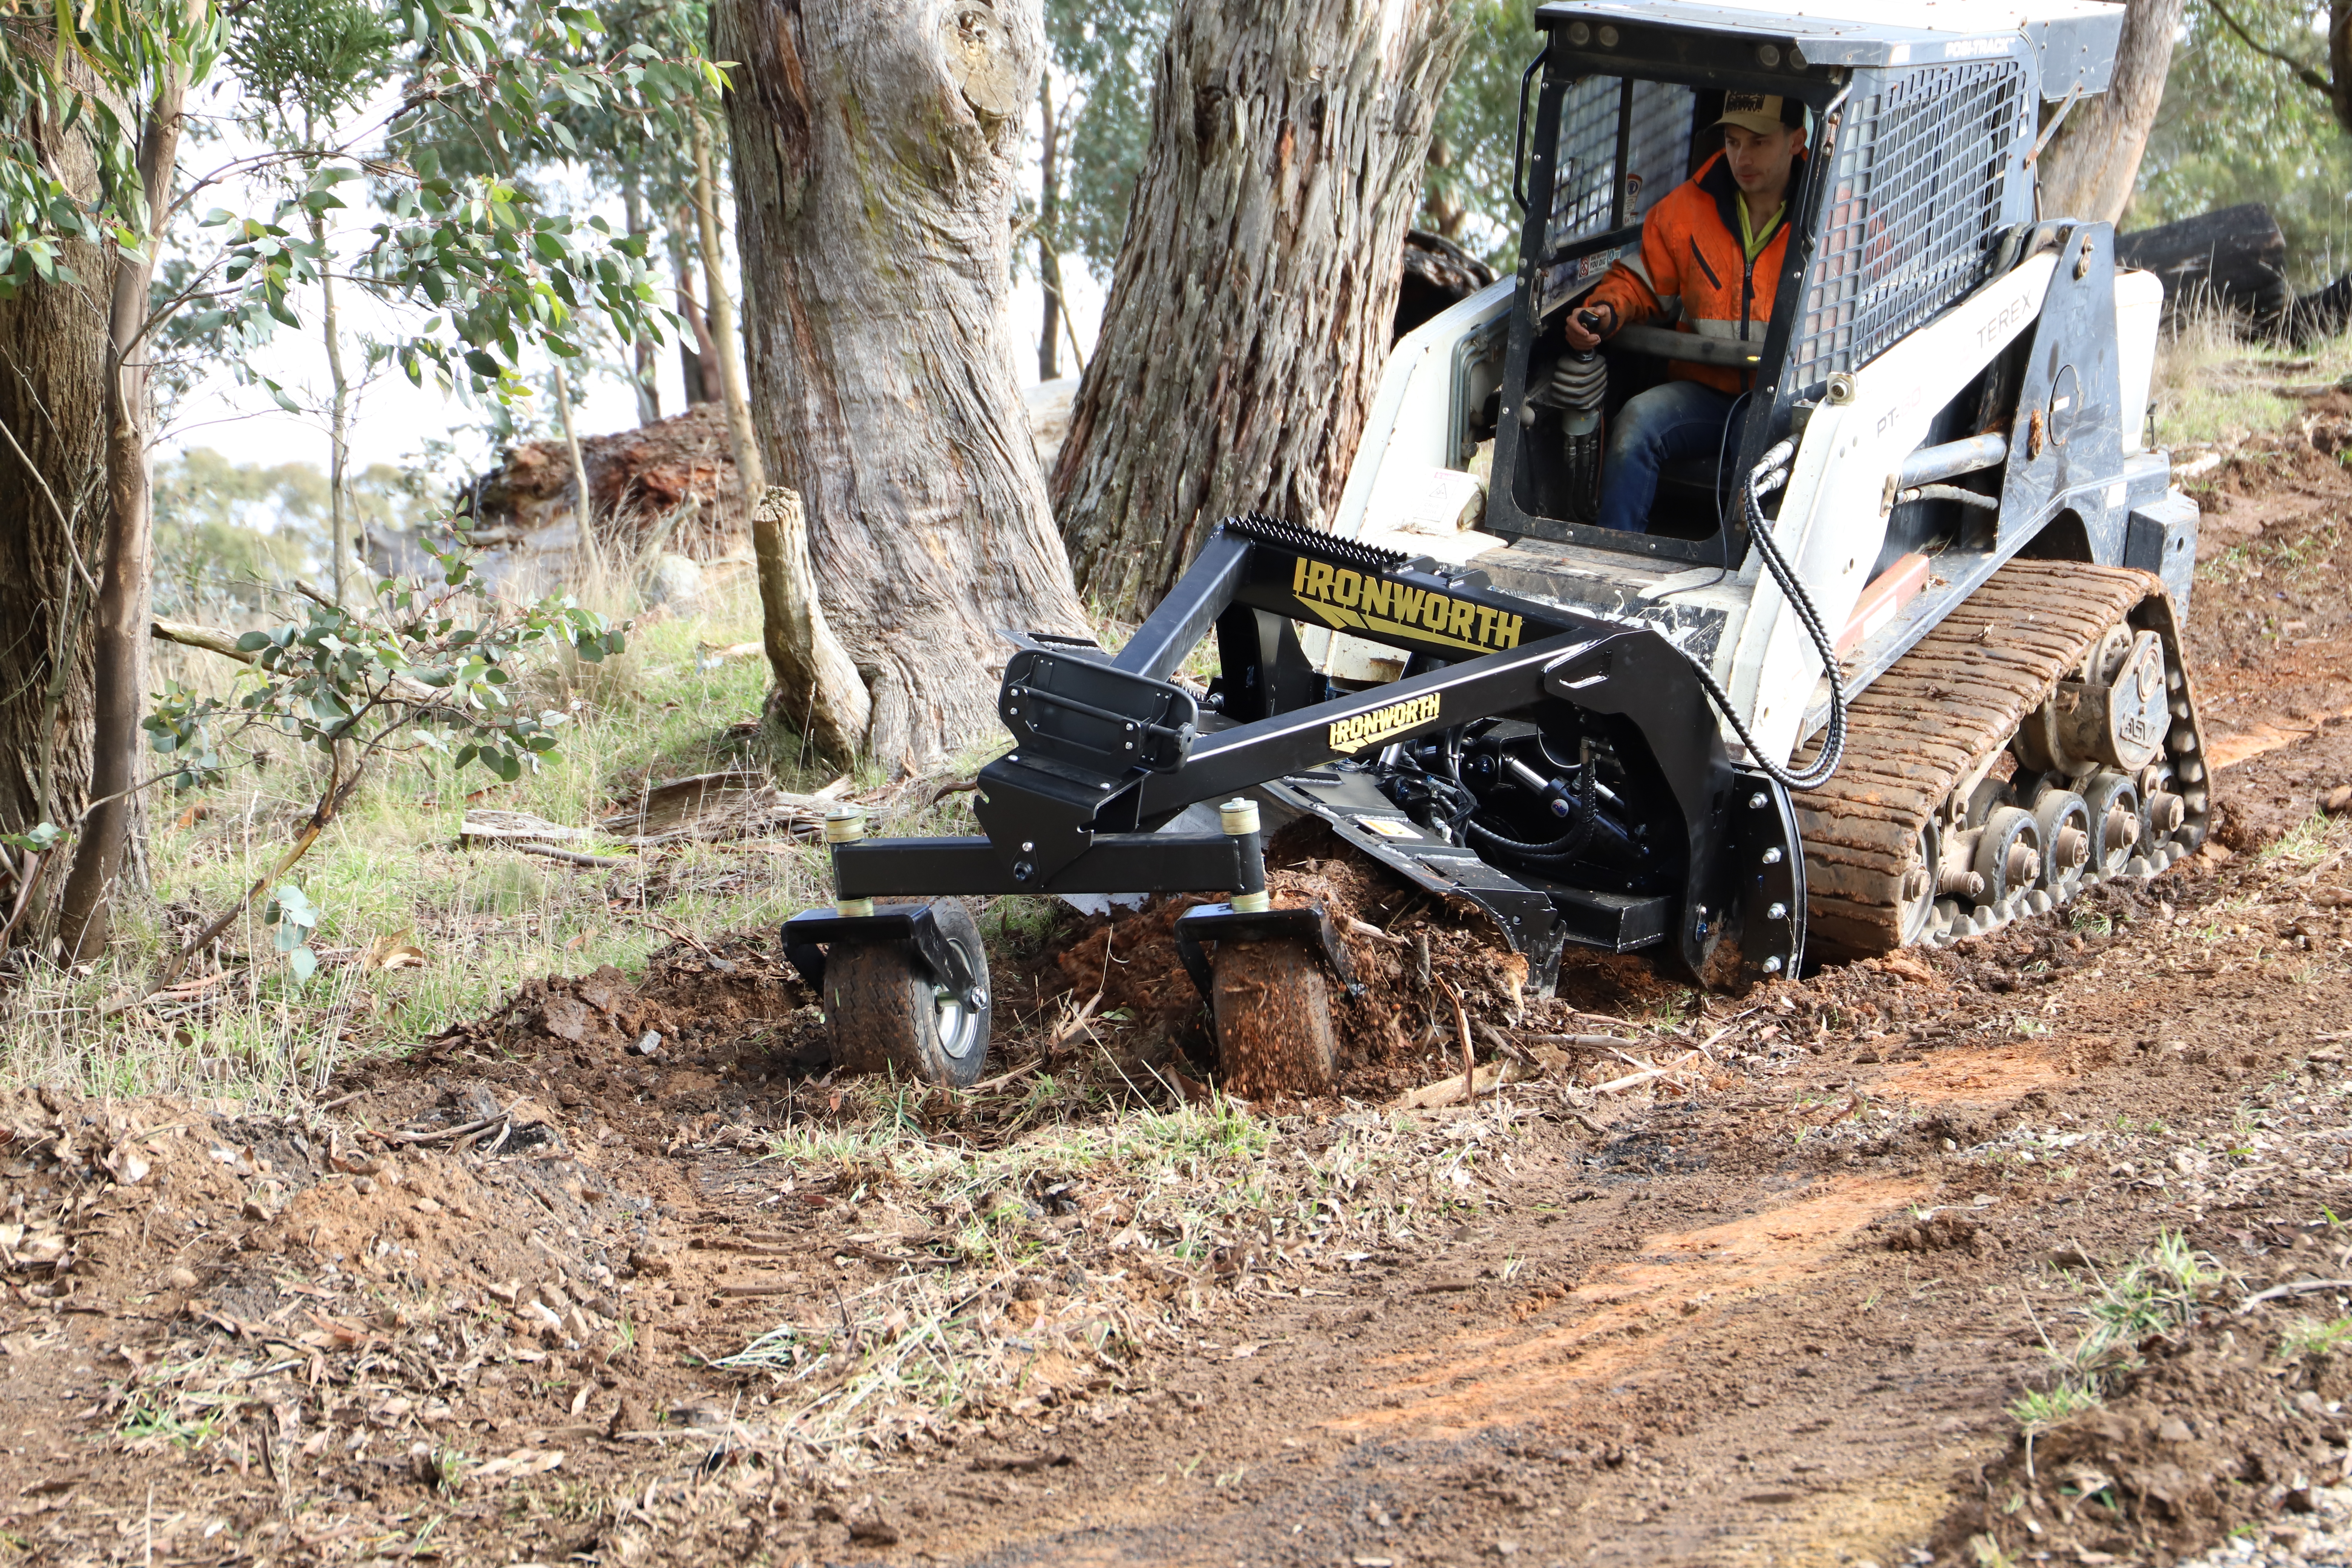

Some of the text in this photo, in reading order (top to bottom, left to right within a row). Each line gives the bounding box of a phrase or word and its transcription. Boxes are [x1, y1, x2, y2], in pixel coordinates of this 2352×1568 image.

[1590, 260, 1599, 269] YOU
[1977, 289, 2031, 349] TEREX
[1877, 385, 1921, 439] PT-60
[1293, 556, 1523, 649] IRONWORTH
[1329, 692, 1441, 746] IRONWORTH
